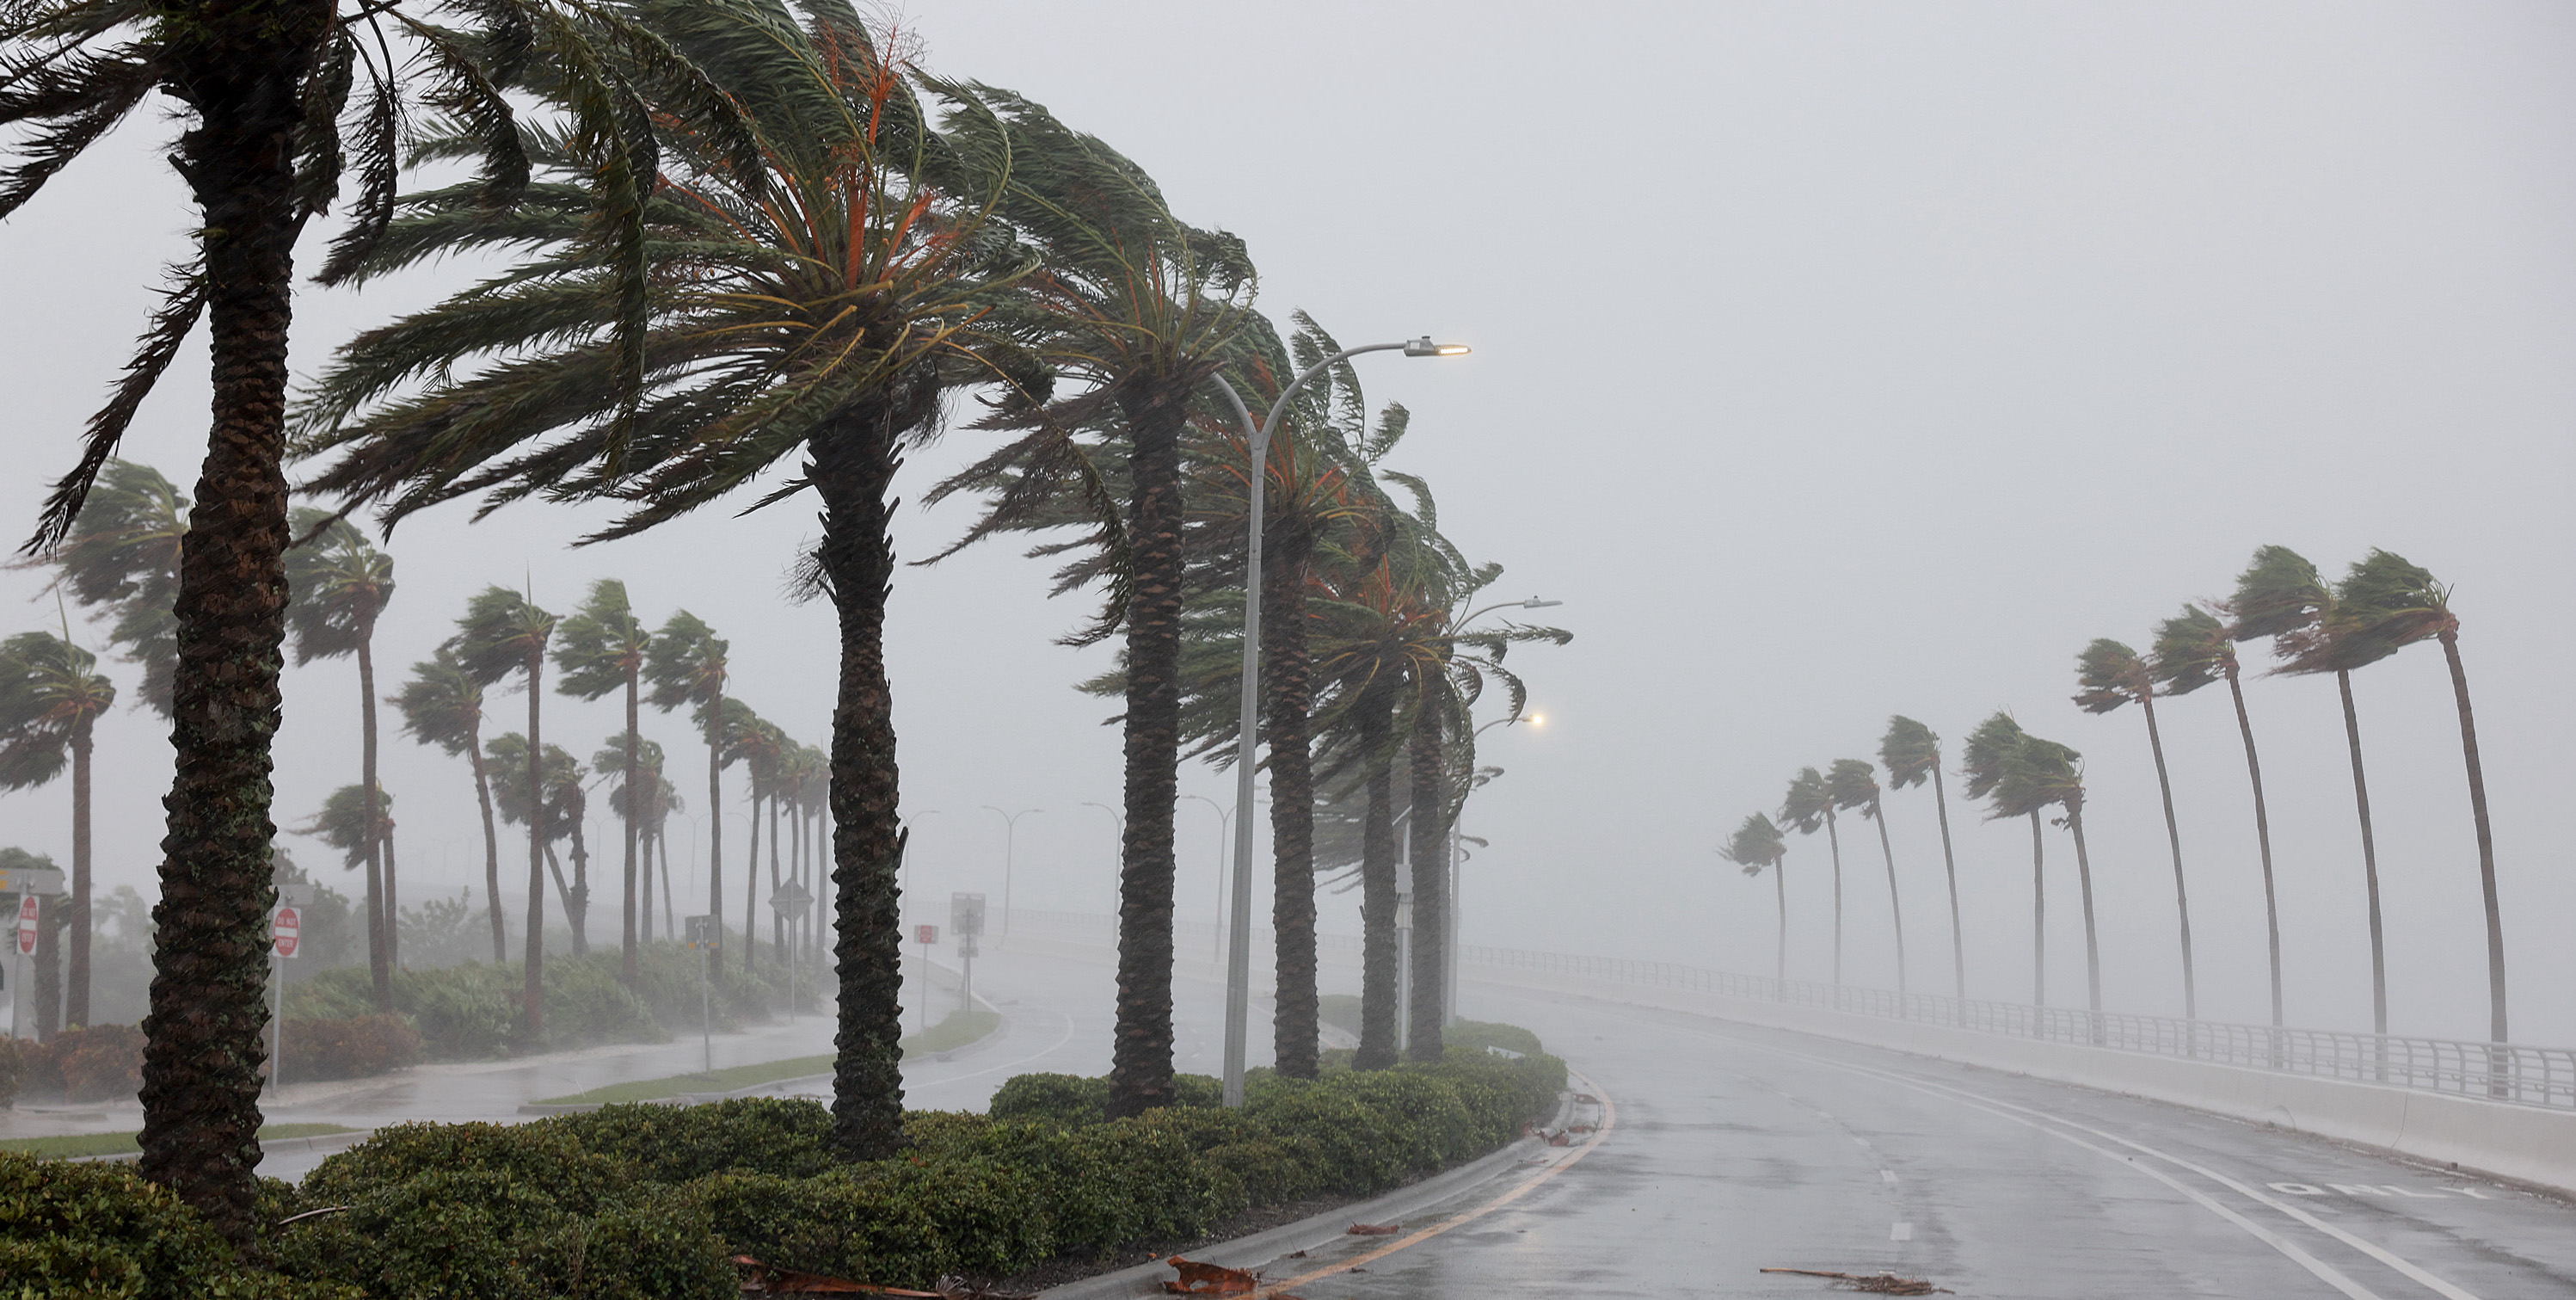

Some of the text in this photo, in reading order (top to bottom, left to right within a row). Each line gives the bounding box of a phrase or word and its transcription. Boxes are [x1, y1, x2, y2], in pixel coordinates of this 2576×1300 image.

[278, 916, 296, 927] DO NOT
[278, 938, 293, 948] ENTER
[2266, 1182, 2490, 1200] ONLY
